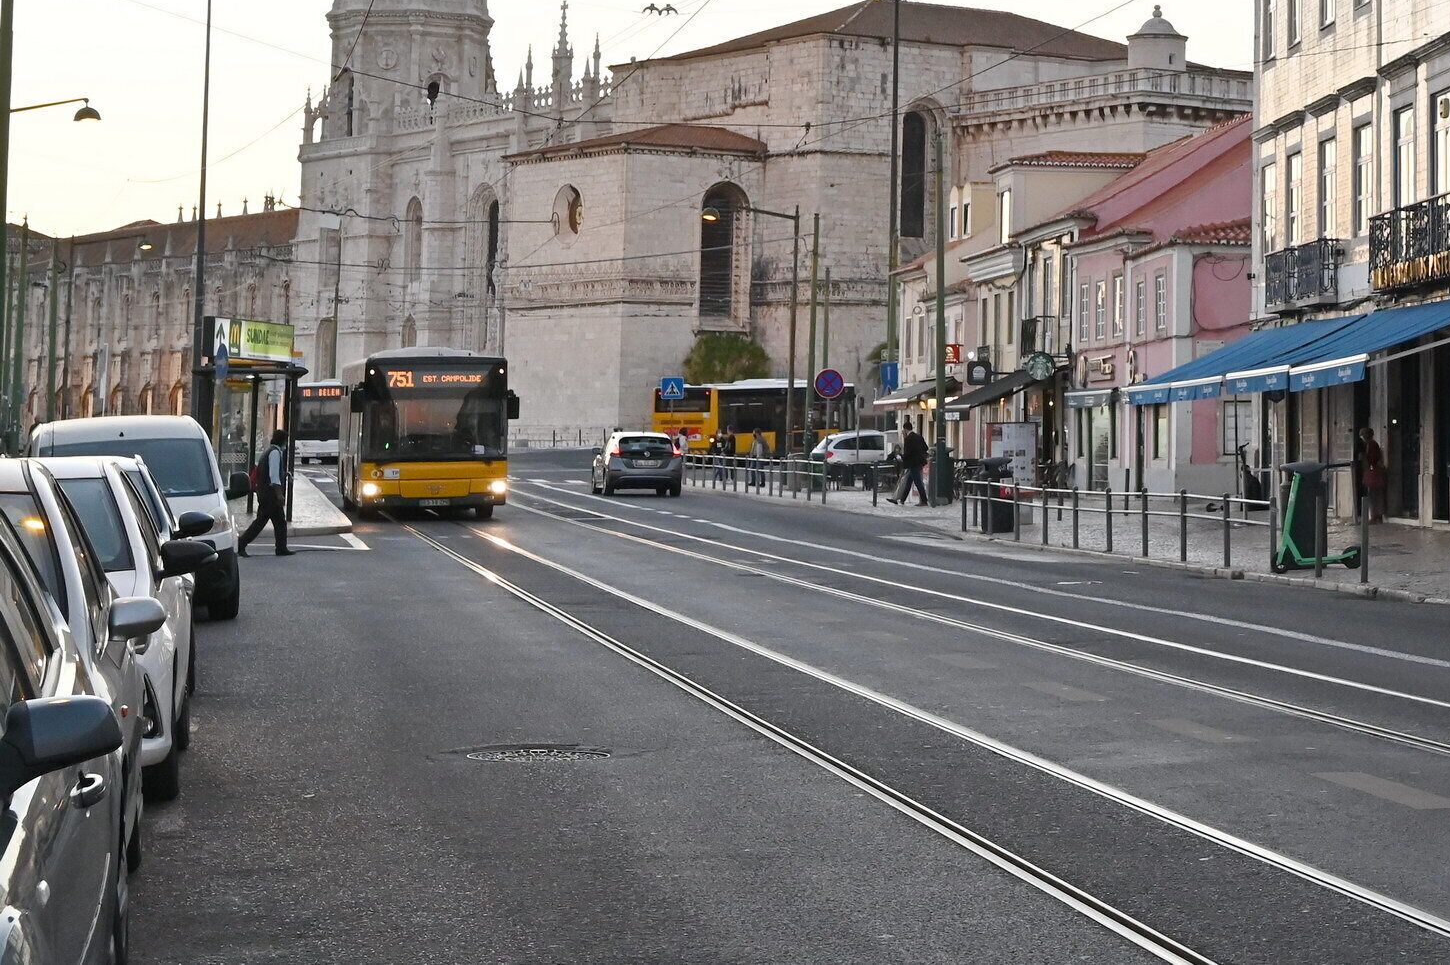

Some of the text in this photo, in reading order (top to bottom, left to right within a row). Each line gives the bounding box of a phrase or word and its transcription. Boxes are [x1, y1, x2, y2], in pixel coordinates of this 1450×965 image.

[388, 371, 482, 387] 751 EST. CAMPOLIDE
